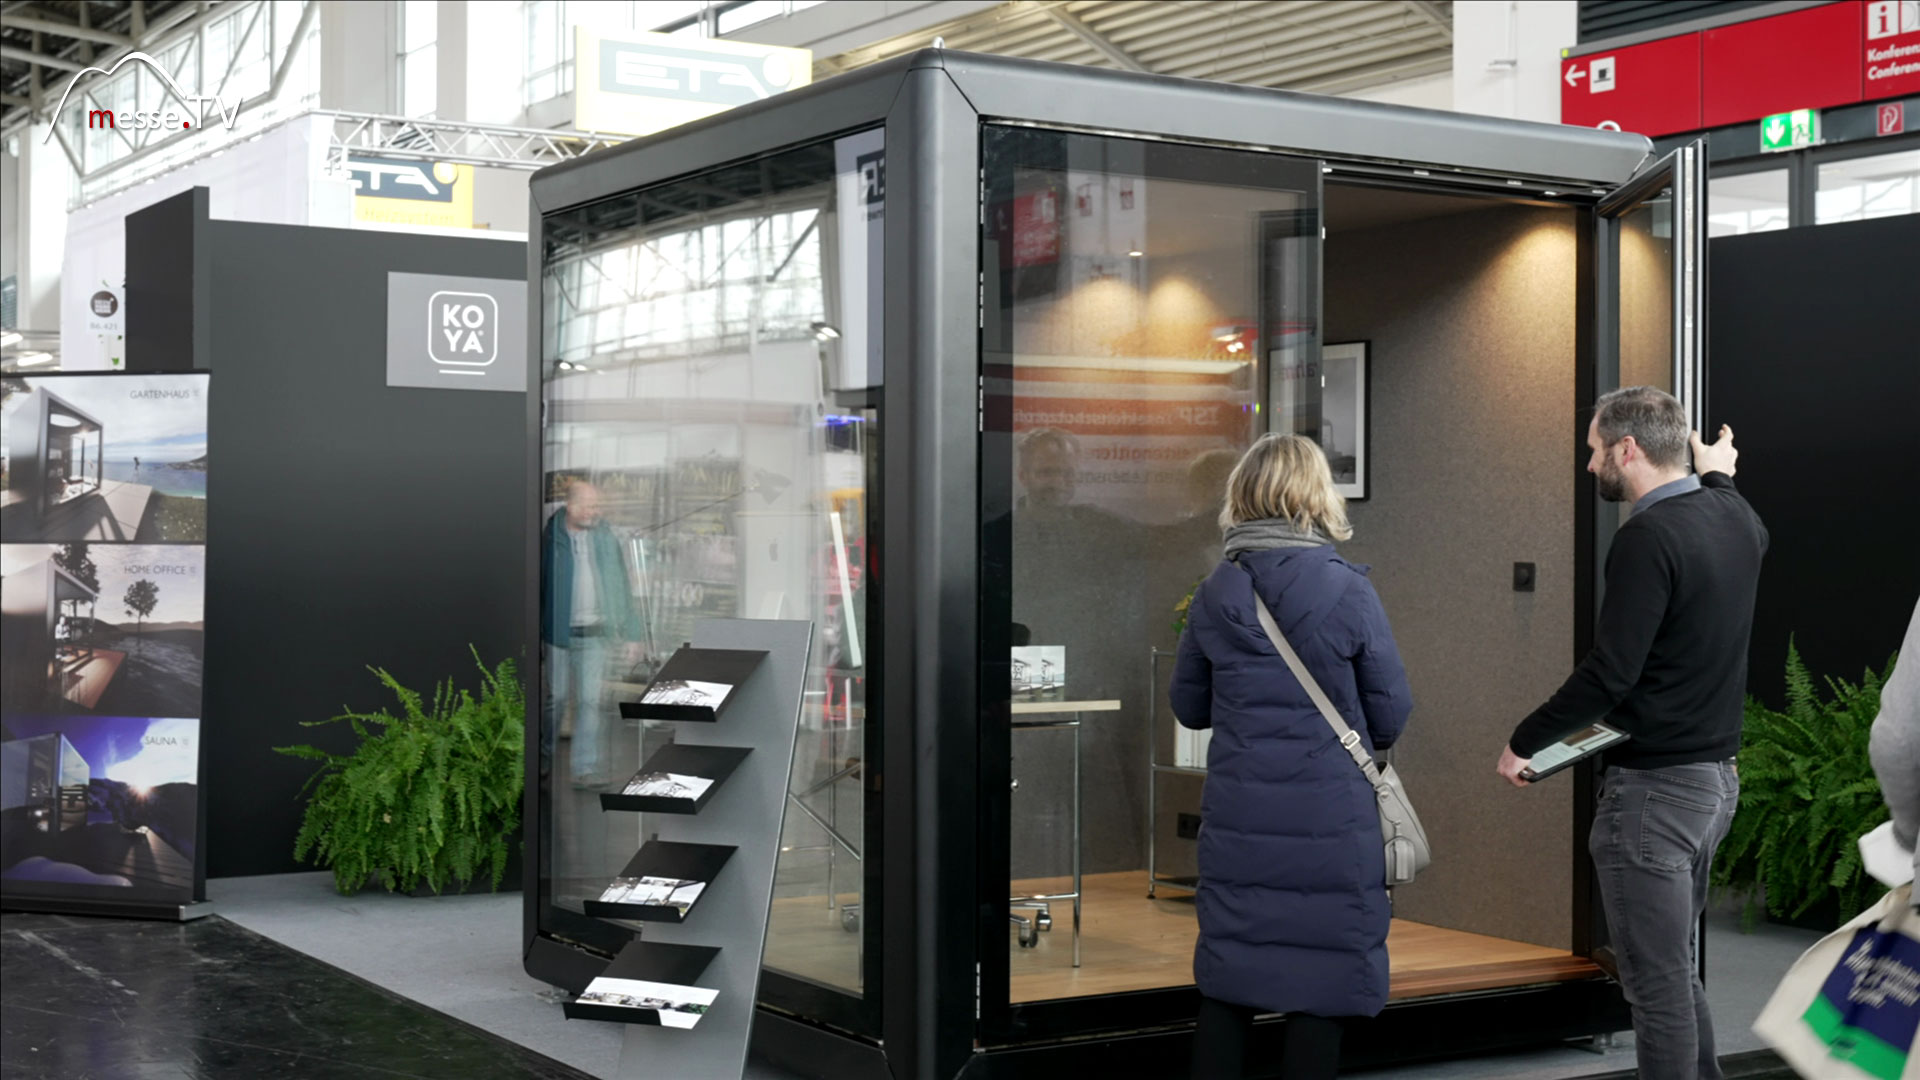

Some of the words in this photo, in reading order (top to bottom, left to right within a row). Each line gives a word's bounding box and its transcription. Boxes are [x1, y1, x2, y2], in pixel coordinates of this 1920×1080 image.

[616, 50, 770, 98] ETA
[129, 389, 190, 399] GARTENHAUS
[124, 564, 150, 575] HOME
[152, 564, 187, 575] OFFICE
[144, 735, 178, 746] SAUNA
